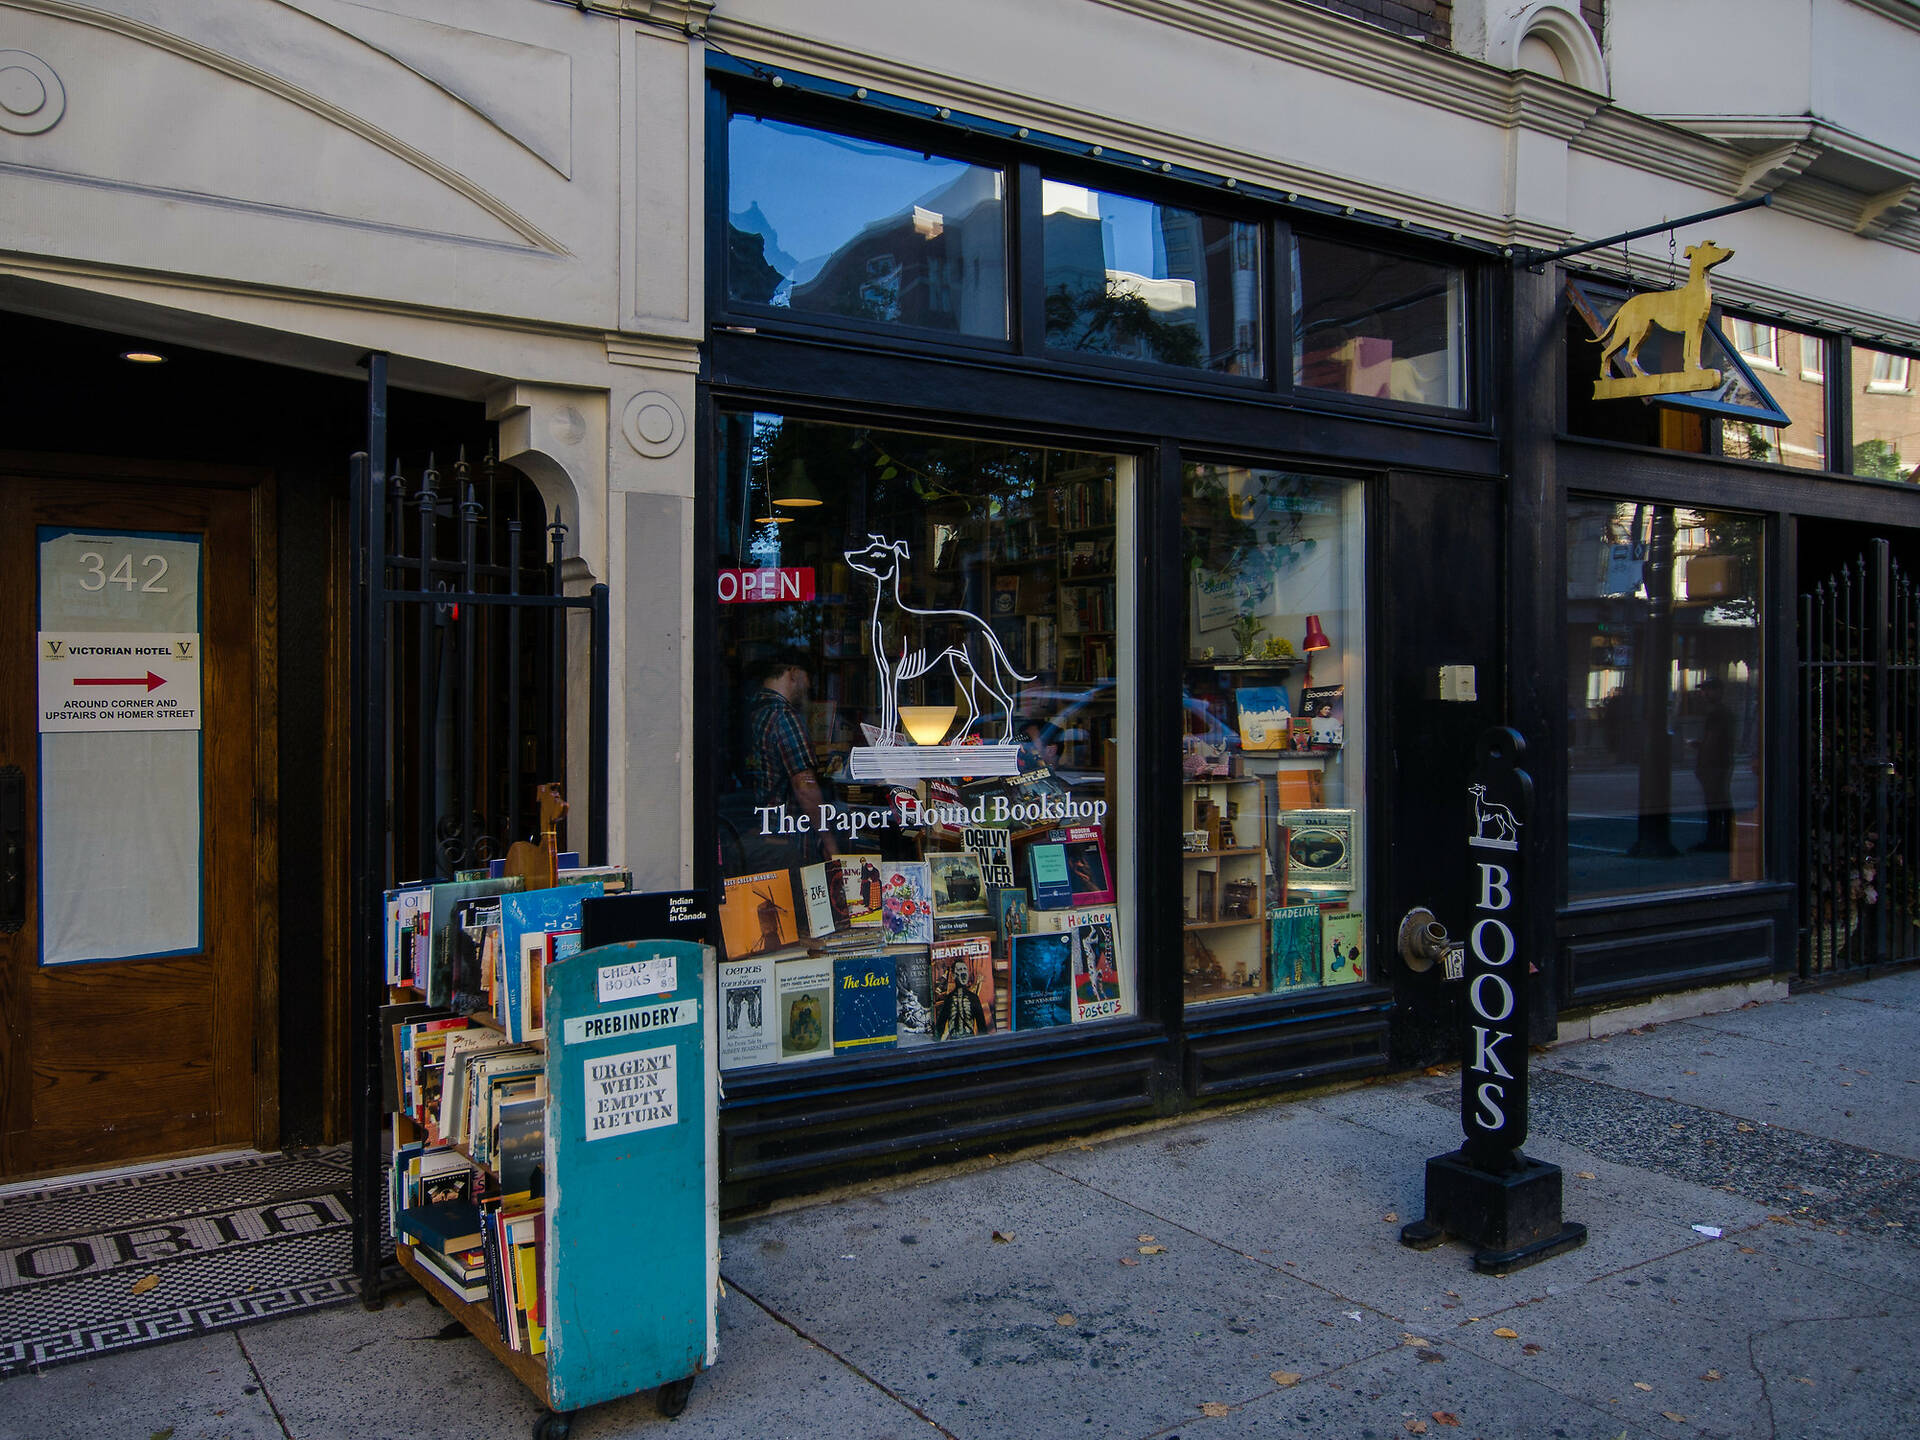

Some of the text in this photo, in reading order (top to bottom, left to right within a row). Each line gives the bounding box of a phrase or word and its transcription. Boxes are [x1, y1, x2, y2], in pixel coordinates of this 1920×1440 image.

[78, 551, 169, 593] 342
[717, 571, 800, 601] OPEN
[68, 646, 172, 656] VICTORIAN HOTEL
[63, 699, 178, 709] AROUND CORNER AND
[45, 709, 195, 720] UPSTAIRS ON HOMER STREET
[754, 792, 1108, 840] The Paper Hound Bookshop
[965, 829, 1008, 848] OGILVY
[669, 897, 694, 906] Indian
[669, 905, 688, 914] Arts
[669, 911, 707, 922] in Canada
[1068, 912, 1111, 929] Hockney
[1274, 906, 1320, 920] MADELINE
[932, 944, 990, 960] HEARTFIELD
[602, 963, 646, 979] CHEAP
[606, 974, 651, 991] BOOKS
[843, 972, 890, 990] The Stars
[1470, 863, 1517, 1131] BOOKS
[1078, 1000, 1121, 1020] Posters
[585, 1007, 680, 1038] PREBINDERY
[592, 1055, 672, 1080] URGENT
[600, 1073, 660, 1095] WHEN
[598, 1089, 666, 1113] EMPTY
[593, 1104, 674, 1130] RETURN
